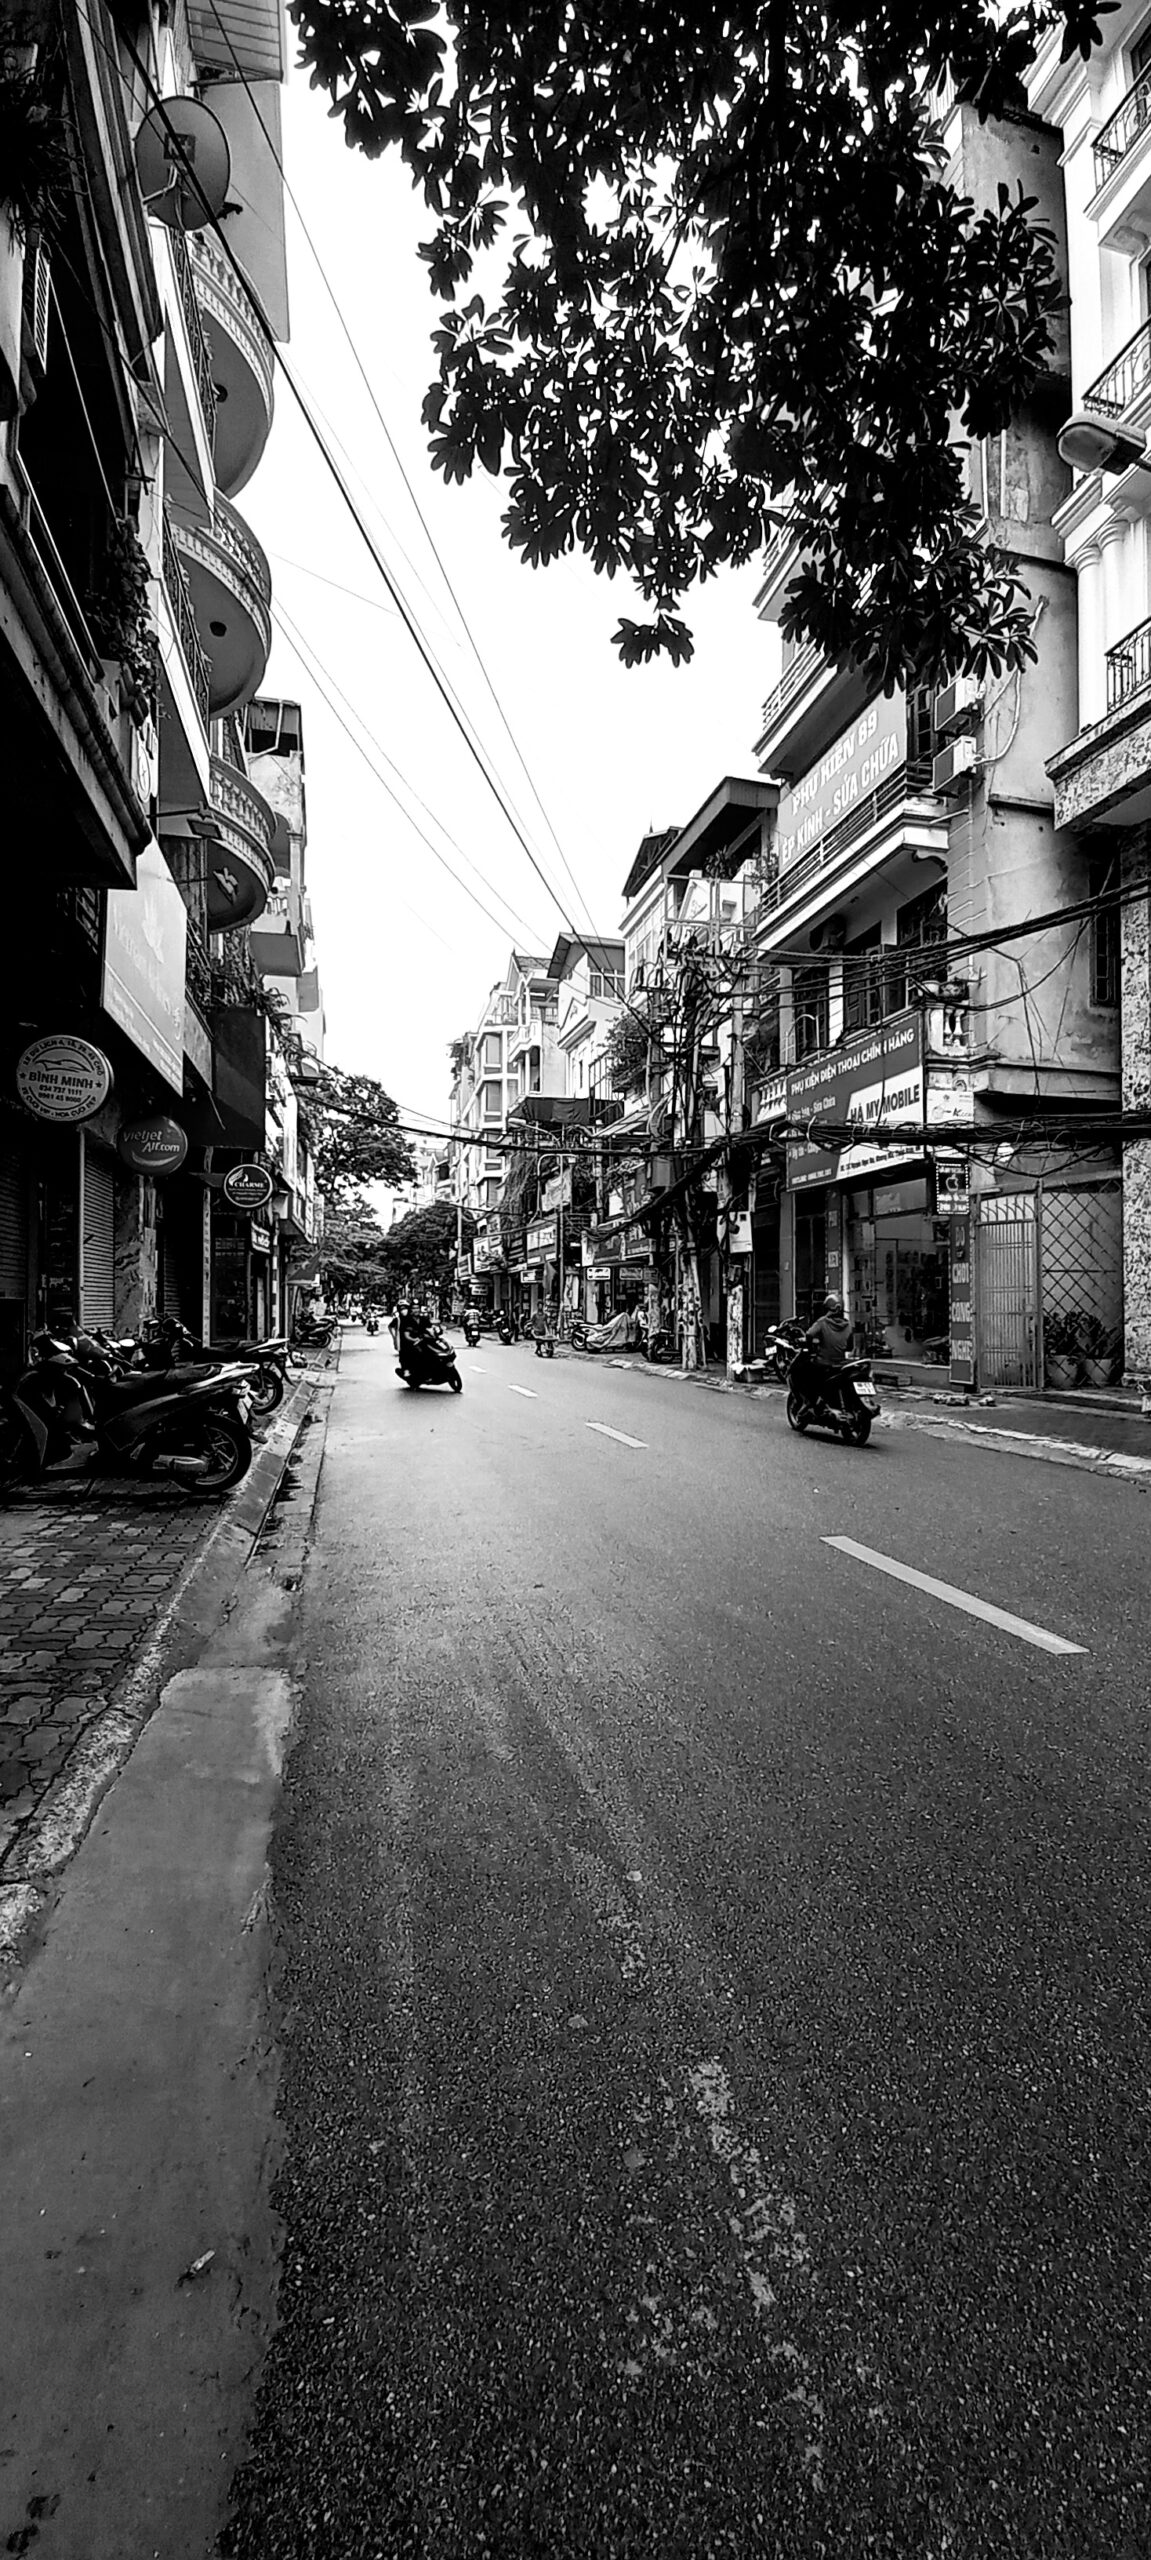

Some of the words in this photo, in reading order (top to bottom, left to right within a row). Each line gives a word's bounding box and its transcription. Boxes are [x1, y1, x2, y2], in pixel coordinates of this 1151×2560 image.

[792, 772, 818, 815] PHỤ
[820, 733, 856, 787] KIỆN
[858, 710, 878, 746] 89
[782, 833, 796, 865] ÉP
[797, 807, 823, 850] KÍNH
[833, 772, 857, 815] SỬA
[861, 733, 898, 788] CHỮA
[29, 1071, 58, 1085] BÌNH
[61, 1076, 93, 1089] MINH
[791, 1078, 804, 1096] PHỤ
[805, 1072, 820, 1090] KIỆN
[820, 1063, 836, 1083] ĐIỆN
[837, 1053, 860, 1074] THOẠI
[888, 1028, 914, 1052] HÃNG
[866, 1098, 880, 1120] MY
[882, 1083, 920, 1114] MOBILE
